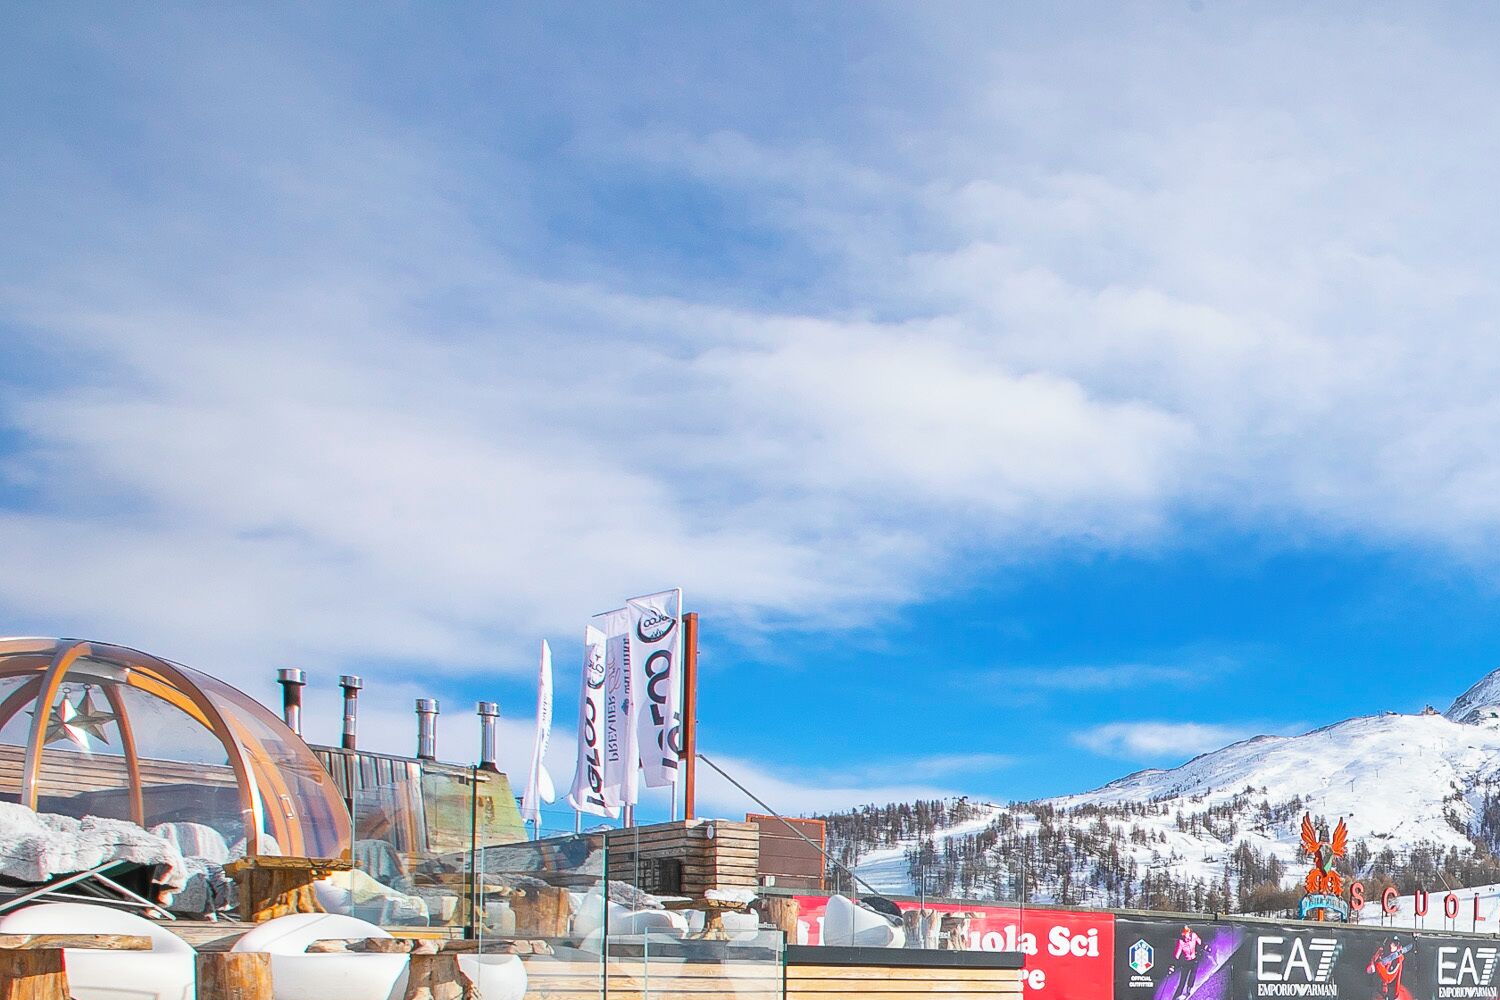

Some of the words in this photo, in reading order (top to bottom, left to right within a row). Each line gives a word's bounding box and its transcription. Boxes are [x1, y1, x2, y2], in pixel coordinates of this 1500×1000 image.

[1048, 925, 1099, 957] Sci
[1258, 936, 1338, 981] EA7
[1438, 946, 1497, 986] EA7
[1258, 984, 1297, 996] EMPORIO
[1305, 984, 1337, 997] ARMANI
[1438, 987, 1469, 998] EMPORIO
[1473, 987, 1497, 998] ARMANI
